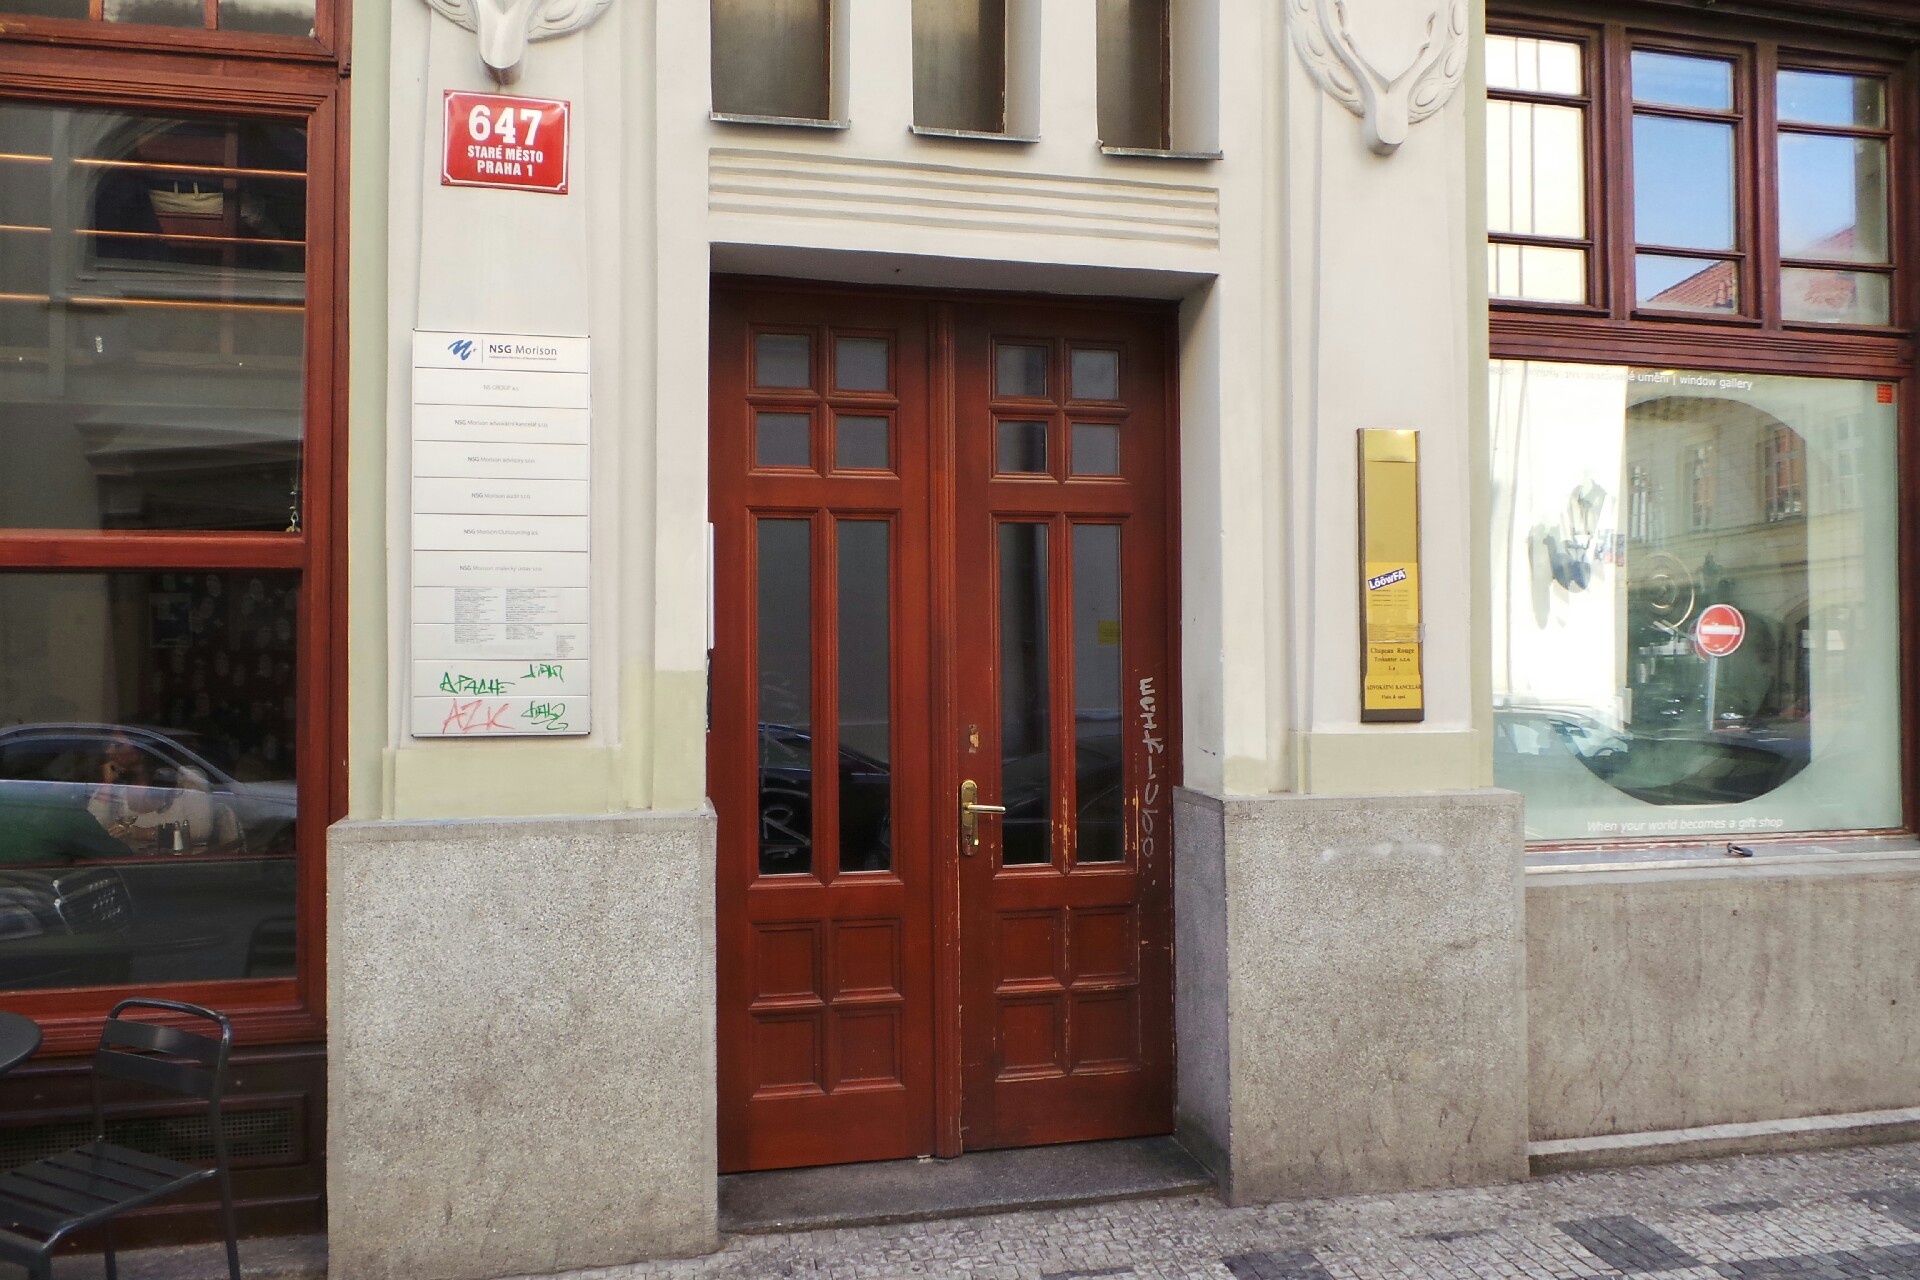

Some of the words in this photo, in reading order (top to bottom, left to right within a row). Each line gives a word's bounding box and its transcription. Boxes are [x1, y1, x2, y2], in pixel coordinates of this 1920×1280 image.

[468, 104, 542, 146] 647
[467, 145, 503, 160] STARÉ
[505, 146, 544, 163] MĚSTO
[477, 160, 521, 176] PRAHA
[526, 164, 533, 177] 1
[489, 344, 512, 354] NSG
[516, 345, 557, 355] Morison
[1680, 375, 1716, 386] window
[1719, 378, 1753, 391] gallery
[1587, 821, 1617, 832] When
[1620, 821, 1645, 833] your
[1648, 818, 1677, 830] world
[1680, 818, 1726, 830] becomes
[1729, 819, 1735, 828] a
[1738, 817, 1756, 831] gift
[1758, 817, 1784, 829] shop
